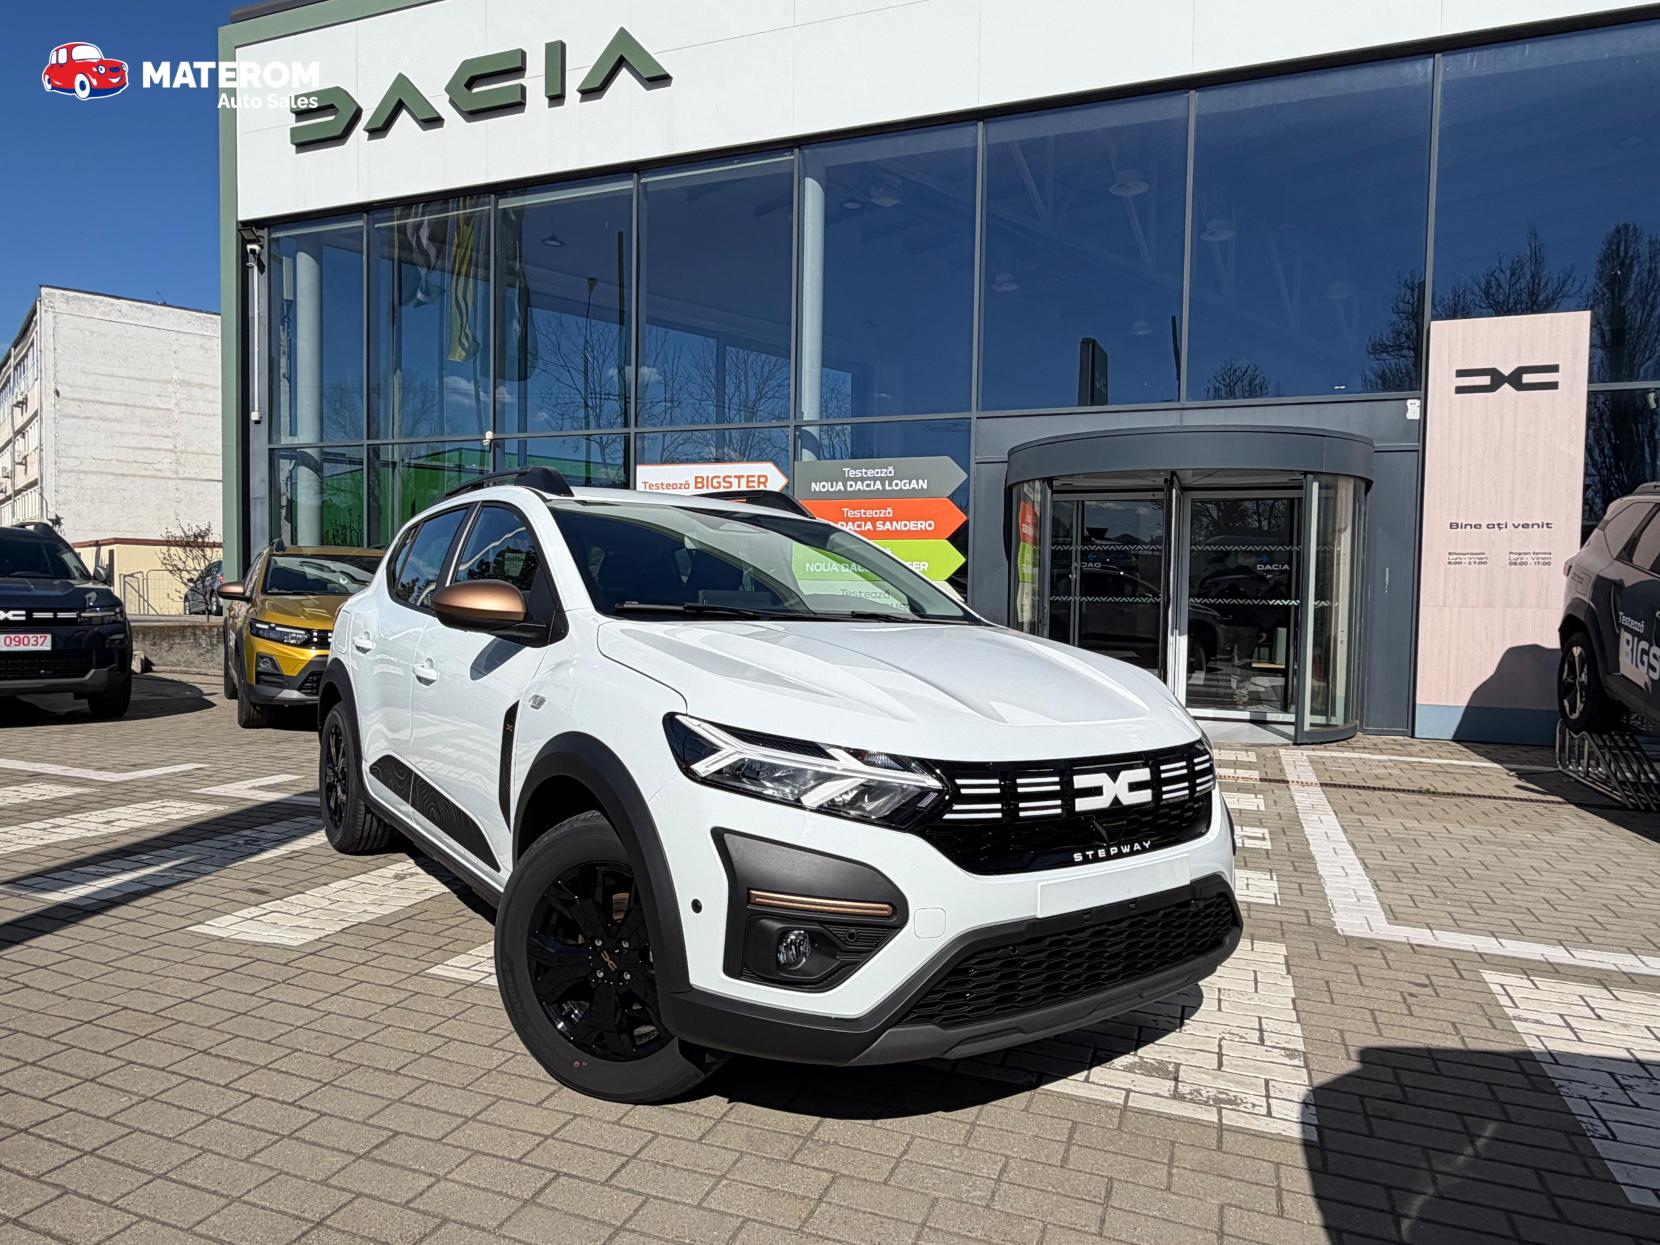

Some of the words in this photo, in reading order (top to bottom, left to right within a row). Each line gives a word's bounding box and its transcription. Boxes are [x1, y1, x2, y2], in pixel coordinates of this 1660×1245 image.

[290, 26, 673, 149] DACIA
[843, 466, 894, 477] Testează
[642, 481, 689, 490] Testează
[694, 475, 768, 489] BIGSTER
[811, 481, 844, 491] NOUA
[847, 480, 882, 491] DACIA
[885, 479, 928, 490] LOGAN
[842, 507, 893, 518] Testează
[876, 520, 935, 531] SANDERO
[1449, 521, 1482, 530] Bine
[1512, 520, 1553, 529] venit
[806, 562, 837, 572] NOUA
[3, 635, 48, 648] 09037
[1073, 840, 1151, 862] STEPWAY
